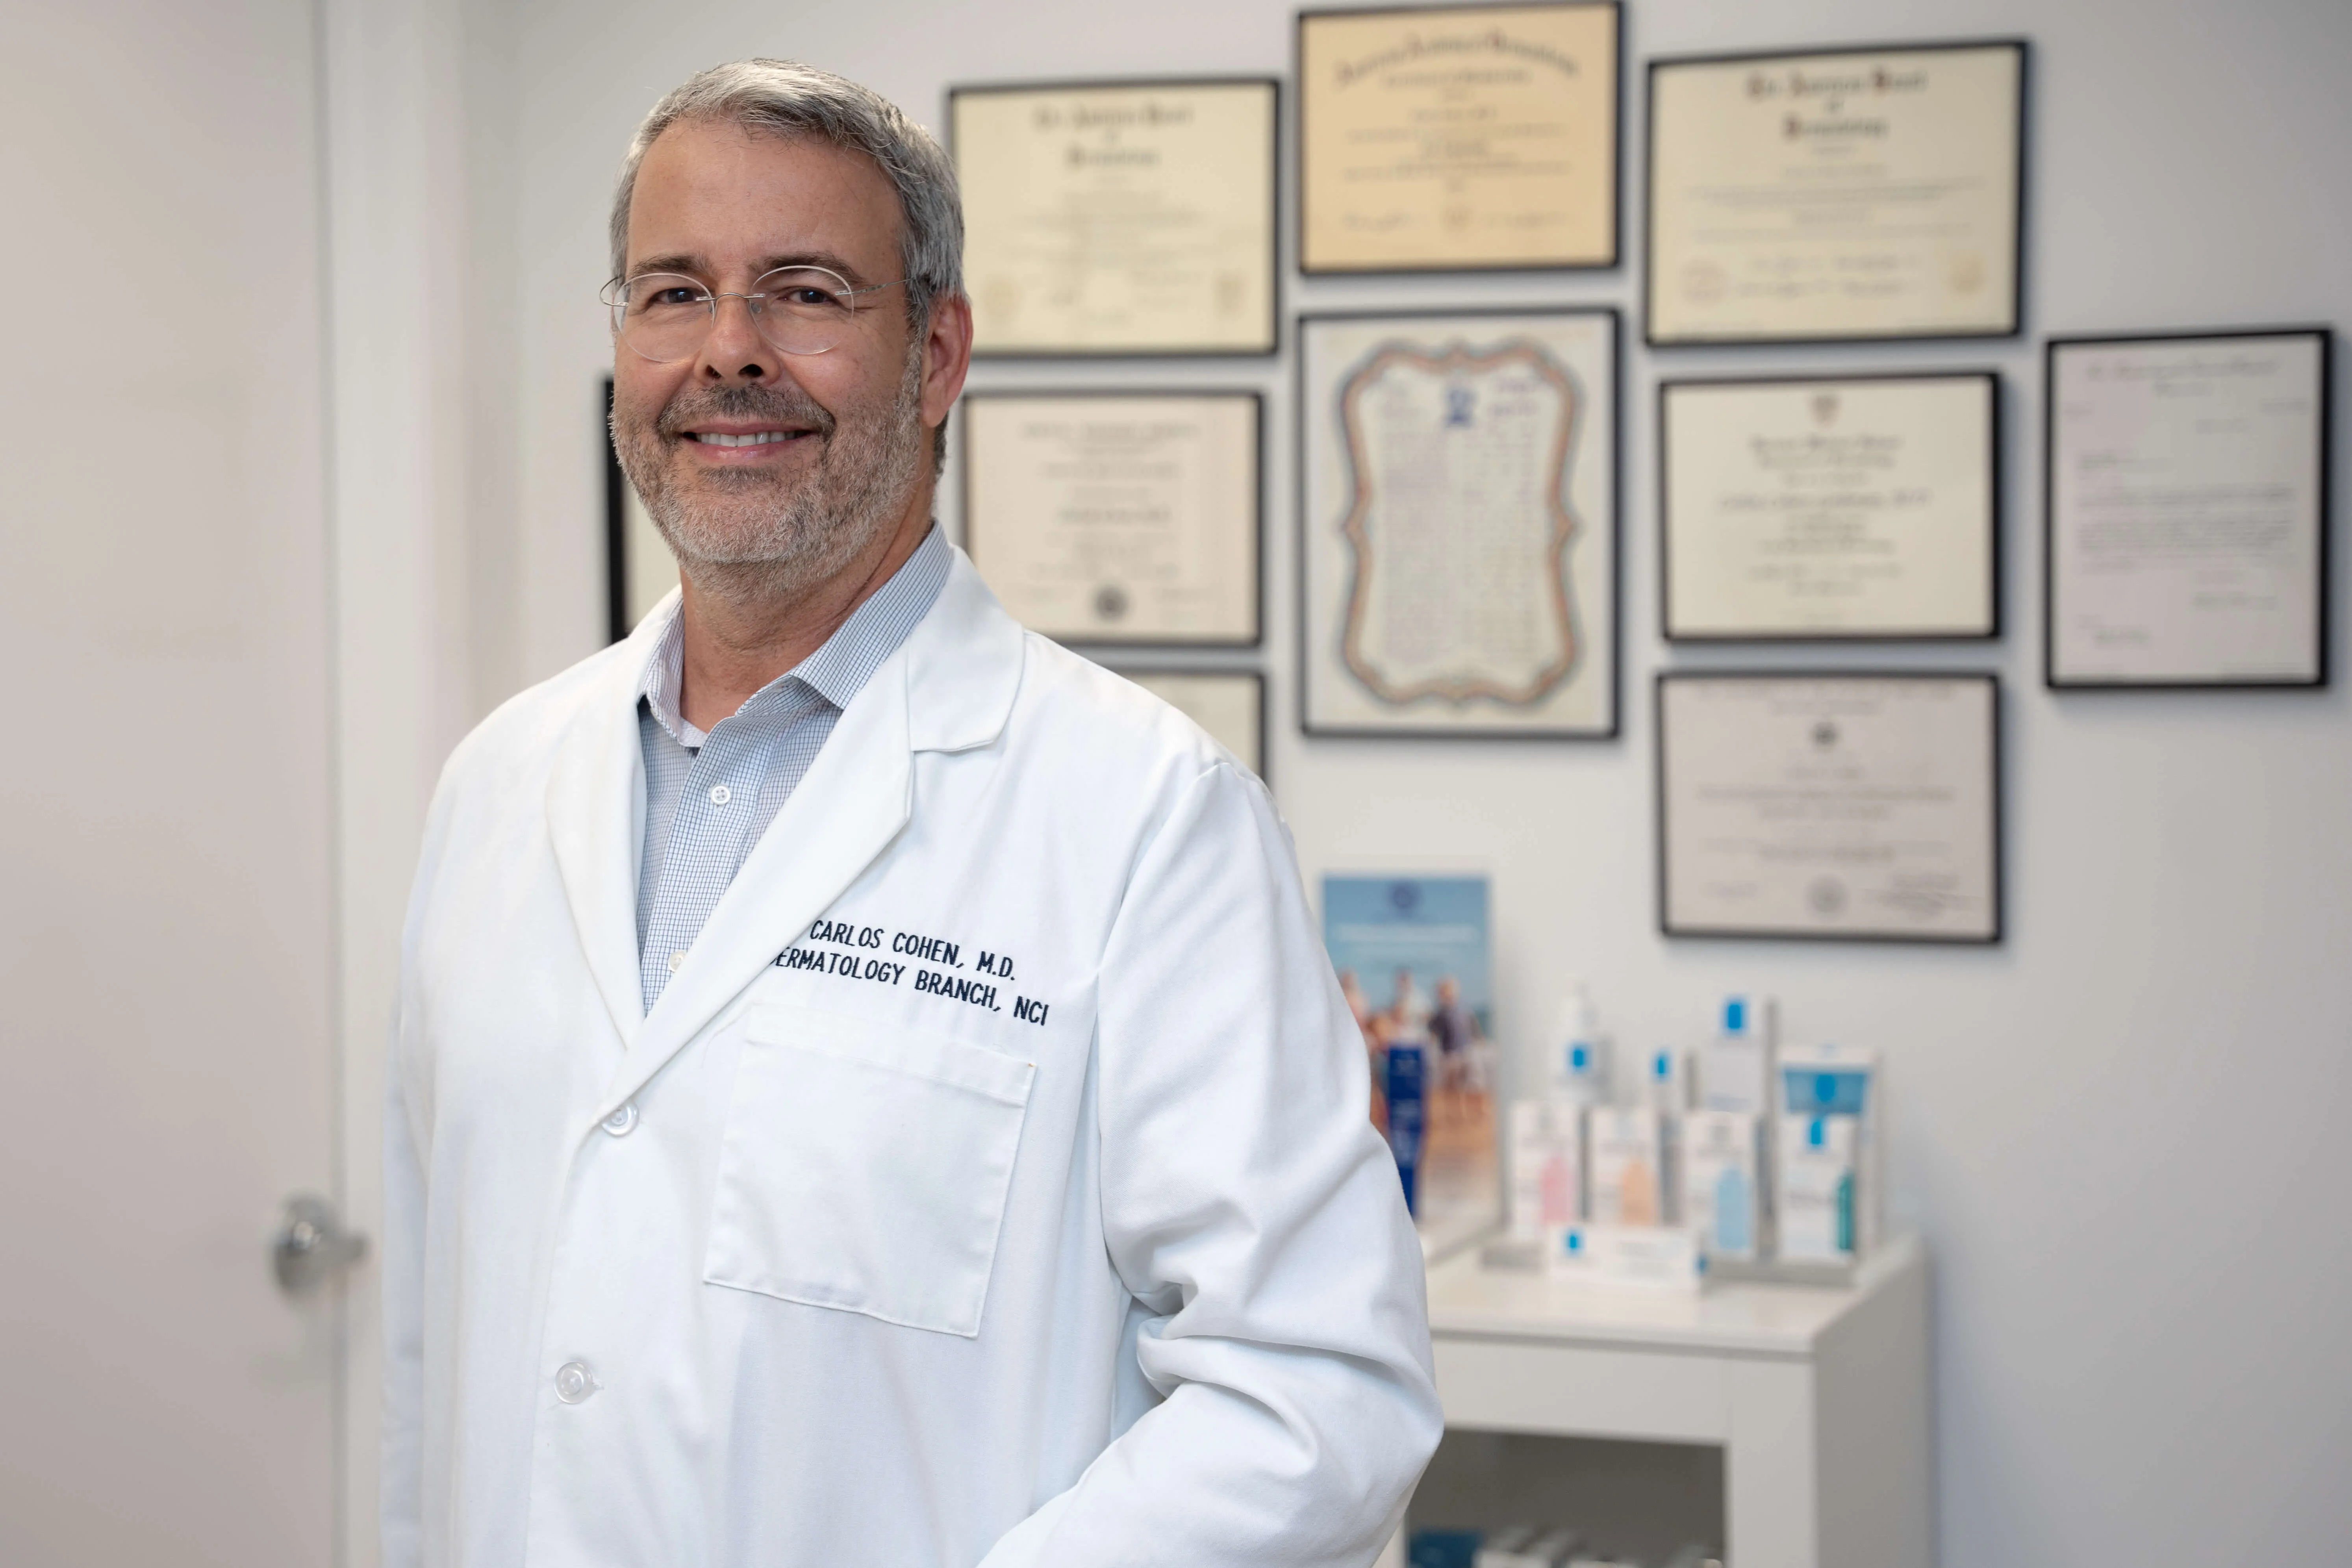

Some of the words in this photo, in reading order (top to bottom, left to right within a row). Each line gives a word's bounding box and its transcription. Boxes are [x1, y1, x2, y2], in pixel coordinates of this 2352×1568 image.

[810, 919, 885, 949] CARLOS
[892, 932, 964, 969] COHEN,
[976, 951, 1016, 981] M.D.
[769, 946, 906, 985] ERMATOLOGY
[914, 970, 1001, 1012] BRANCH,
[1013, 996, 1049, 1026] NCI
